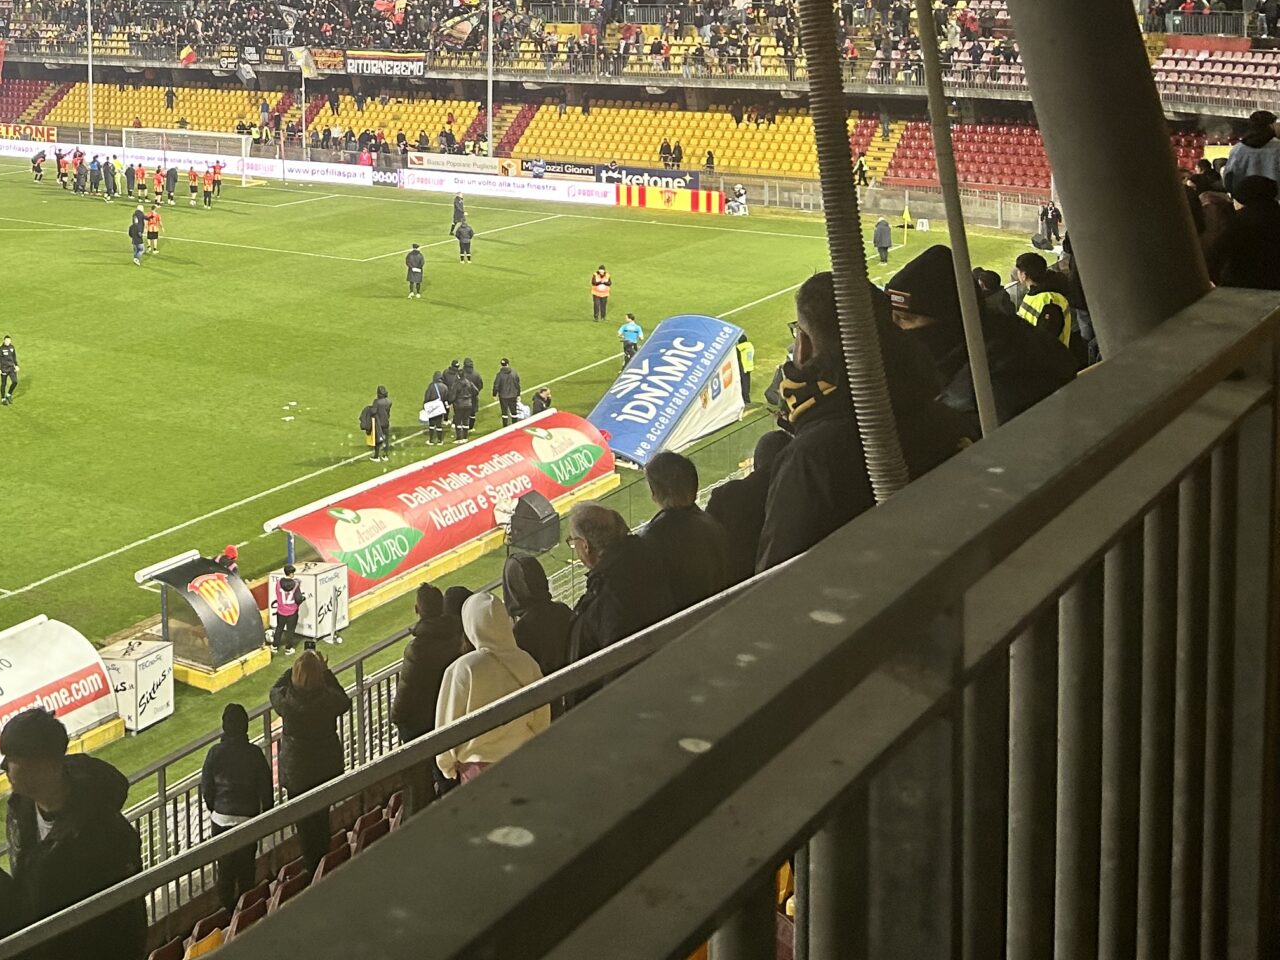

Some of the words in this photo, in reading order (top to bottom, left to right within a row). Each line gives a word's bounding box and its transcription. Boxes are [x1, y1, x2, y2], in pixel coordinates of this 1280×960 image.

[346, 59, 424, 76] RITORNEREMO
[287, 165, 366, 179] www.profiliaspa.it
[372, 170, 398, 183] 90:00
[565, 165, 594, 175] Gianni
[477, 179, 497, 187] volto
[498, 180, 511, 188] alla
[526, 182, 557, 191] finestra
[634, 441, 651, 457] we
[646, 386, 690, 442] accelerate
[685, 363, 706, 391] your
[700, 326, 734, 366] advance
[550, 449, 595, 484] MAURO
[397, 485, 440, 508] Dalla
[439, 469, 471, 496] Valle
[469, 448, 525, 479] Caudina
[429, 503, 479, 530] Natura
[478, 496, 489, 509] e
[487, 473, 533, 504] Sapore
[354, 534, 410, 577] MAURO
[279, 589, 295, 605] 12
